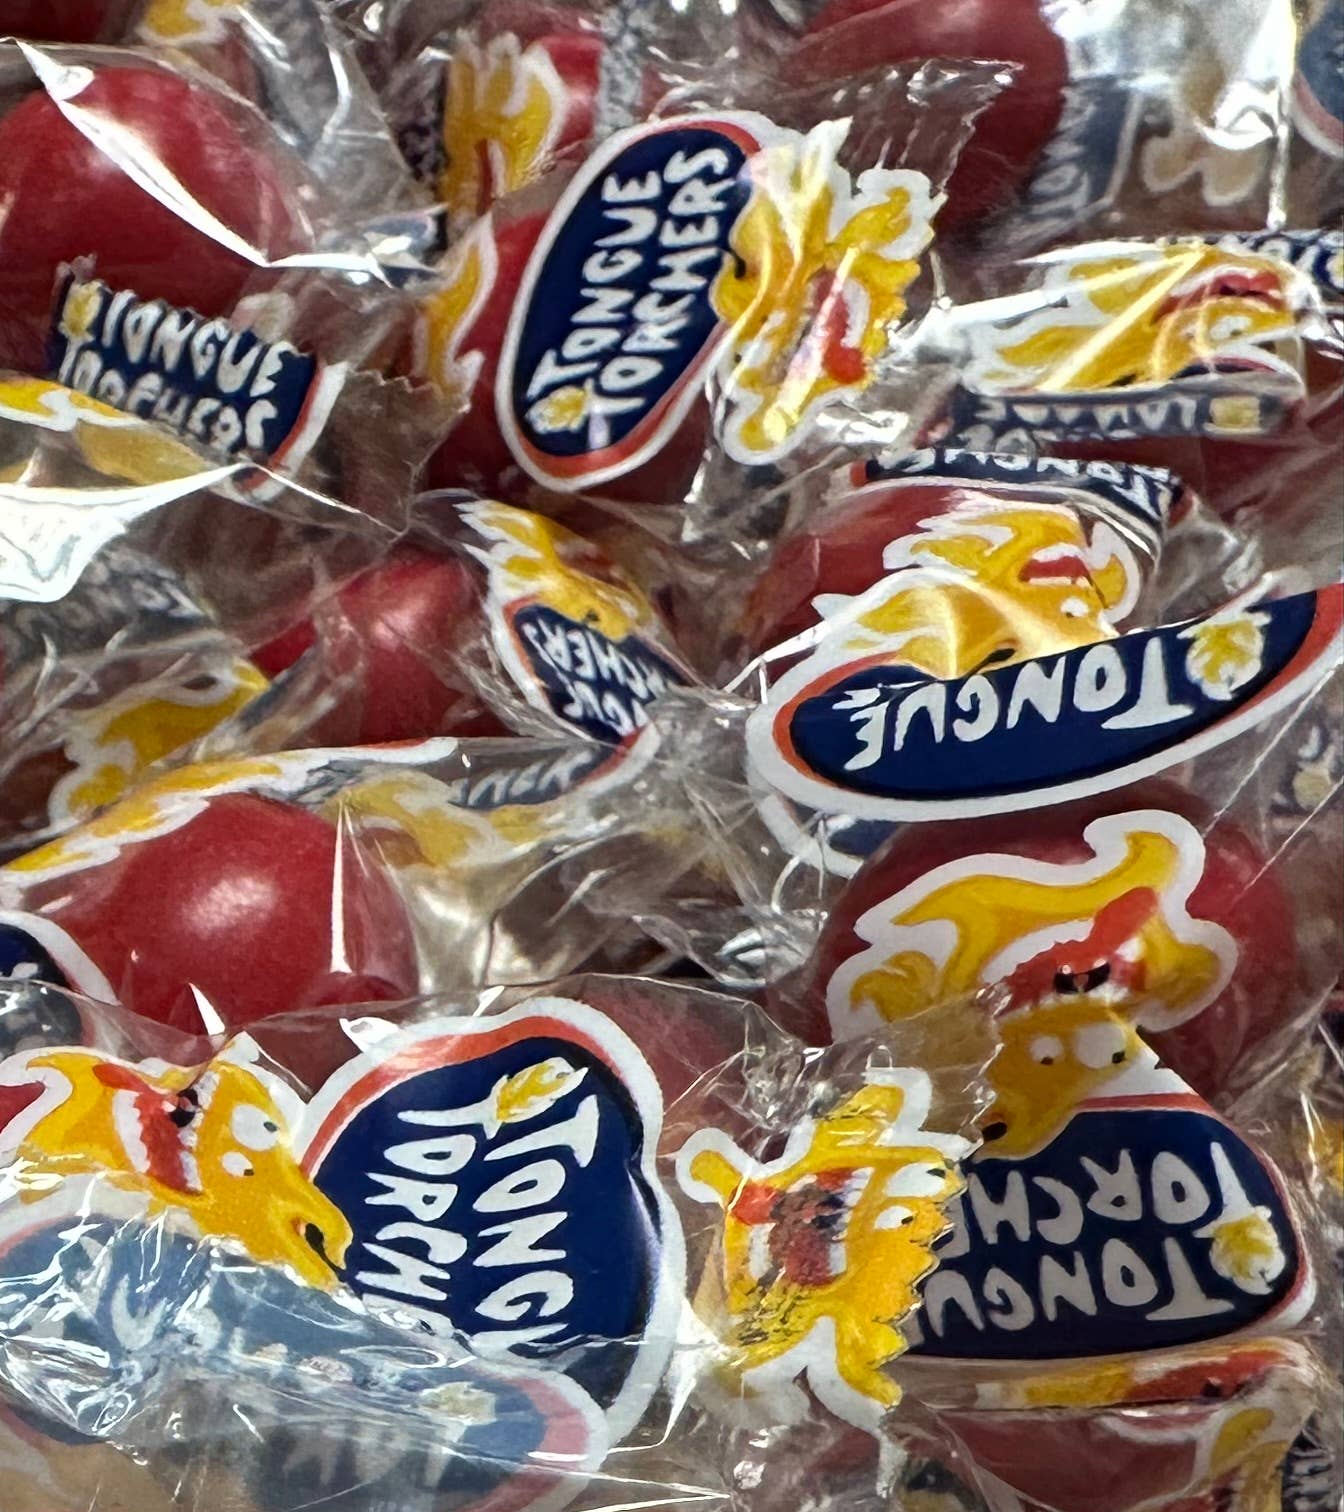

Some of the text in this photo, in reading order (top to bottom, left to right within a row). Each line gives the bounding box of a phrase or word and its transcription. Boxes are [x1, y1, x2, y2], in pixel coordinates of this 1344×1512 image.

[526, 169, 663, 404] TONGUE
[584, 147, 737, 418] TORCHERS
[832, 636, 1194, 771] TONGUE
